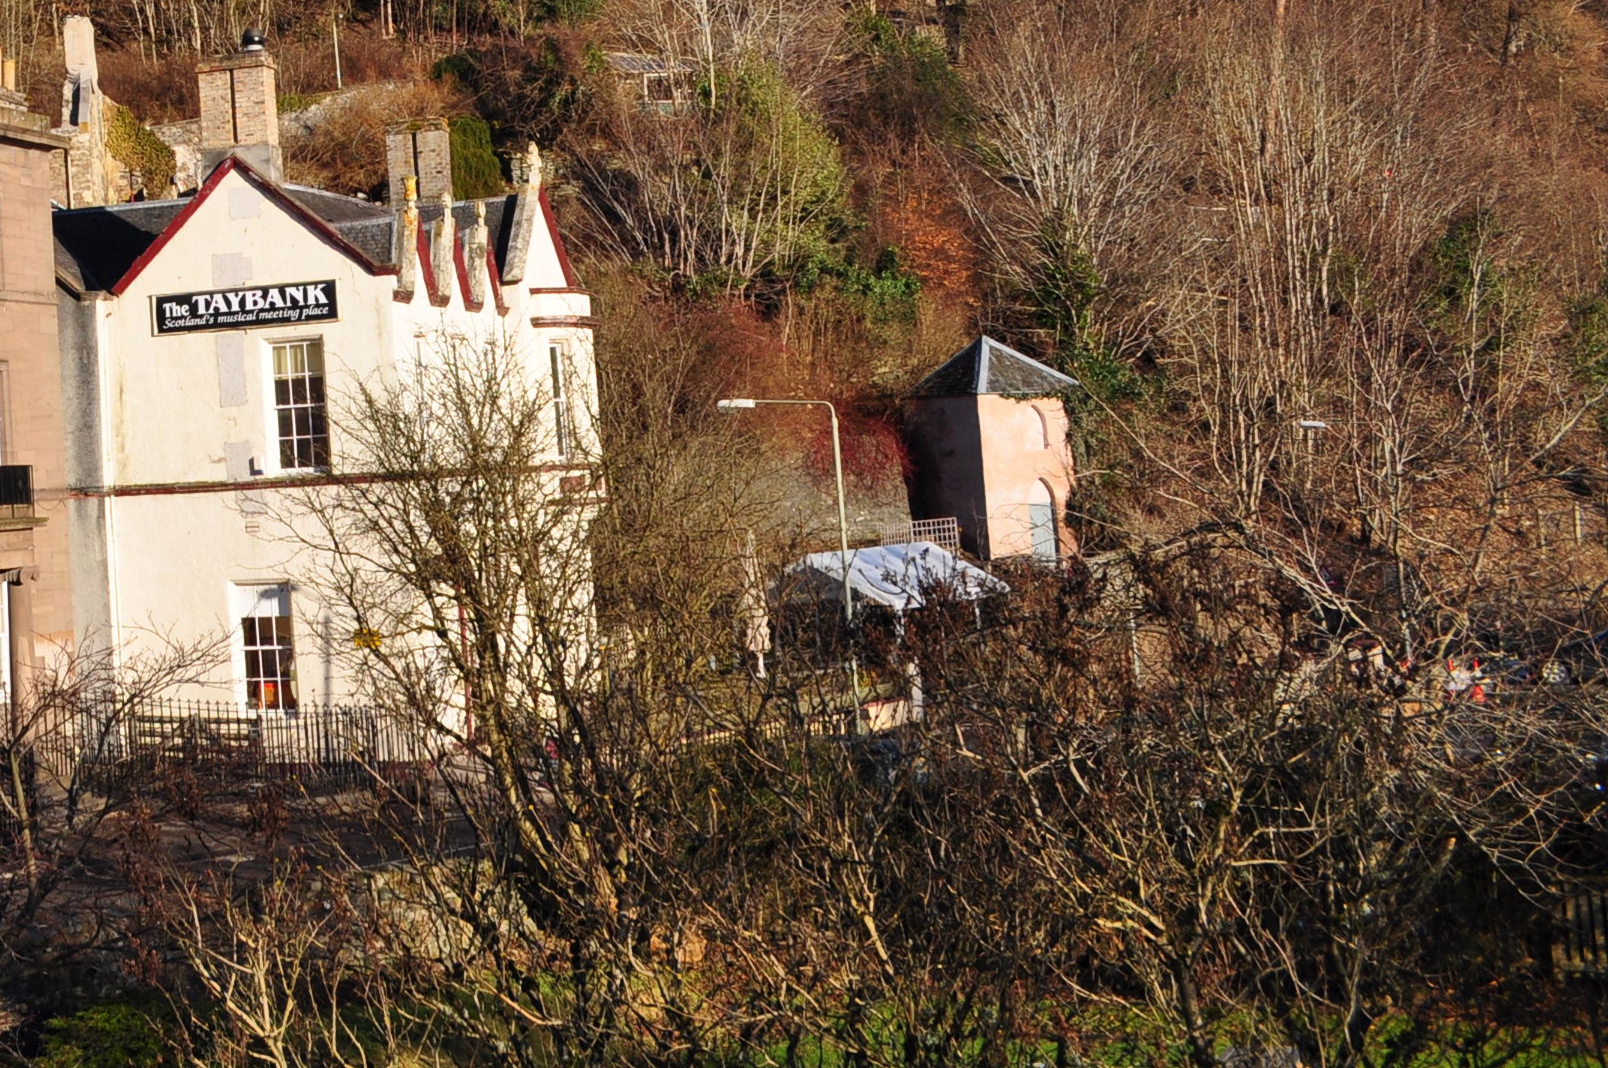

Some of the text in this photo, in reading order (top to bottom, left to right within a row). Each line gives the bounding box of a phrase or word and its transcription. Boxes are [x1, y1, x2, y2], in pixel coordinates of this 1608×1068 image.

[163, 283, 329, 318] The TAYBANK
[163, 304, 329, 329] Scotland's musical meeting place
